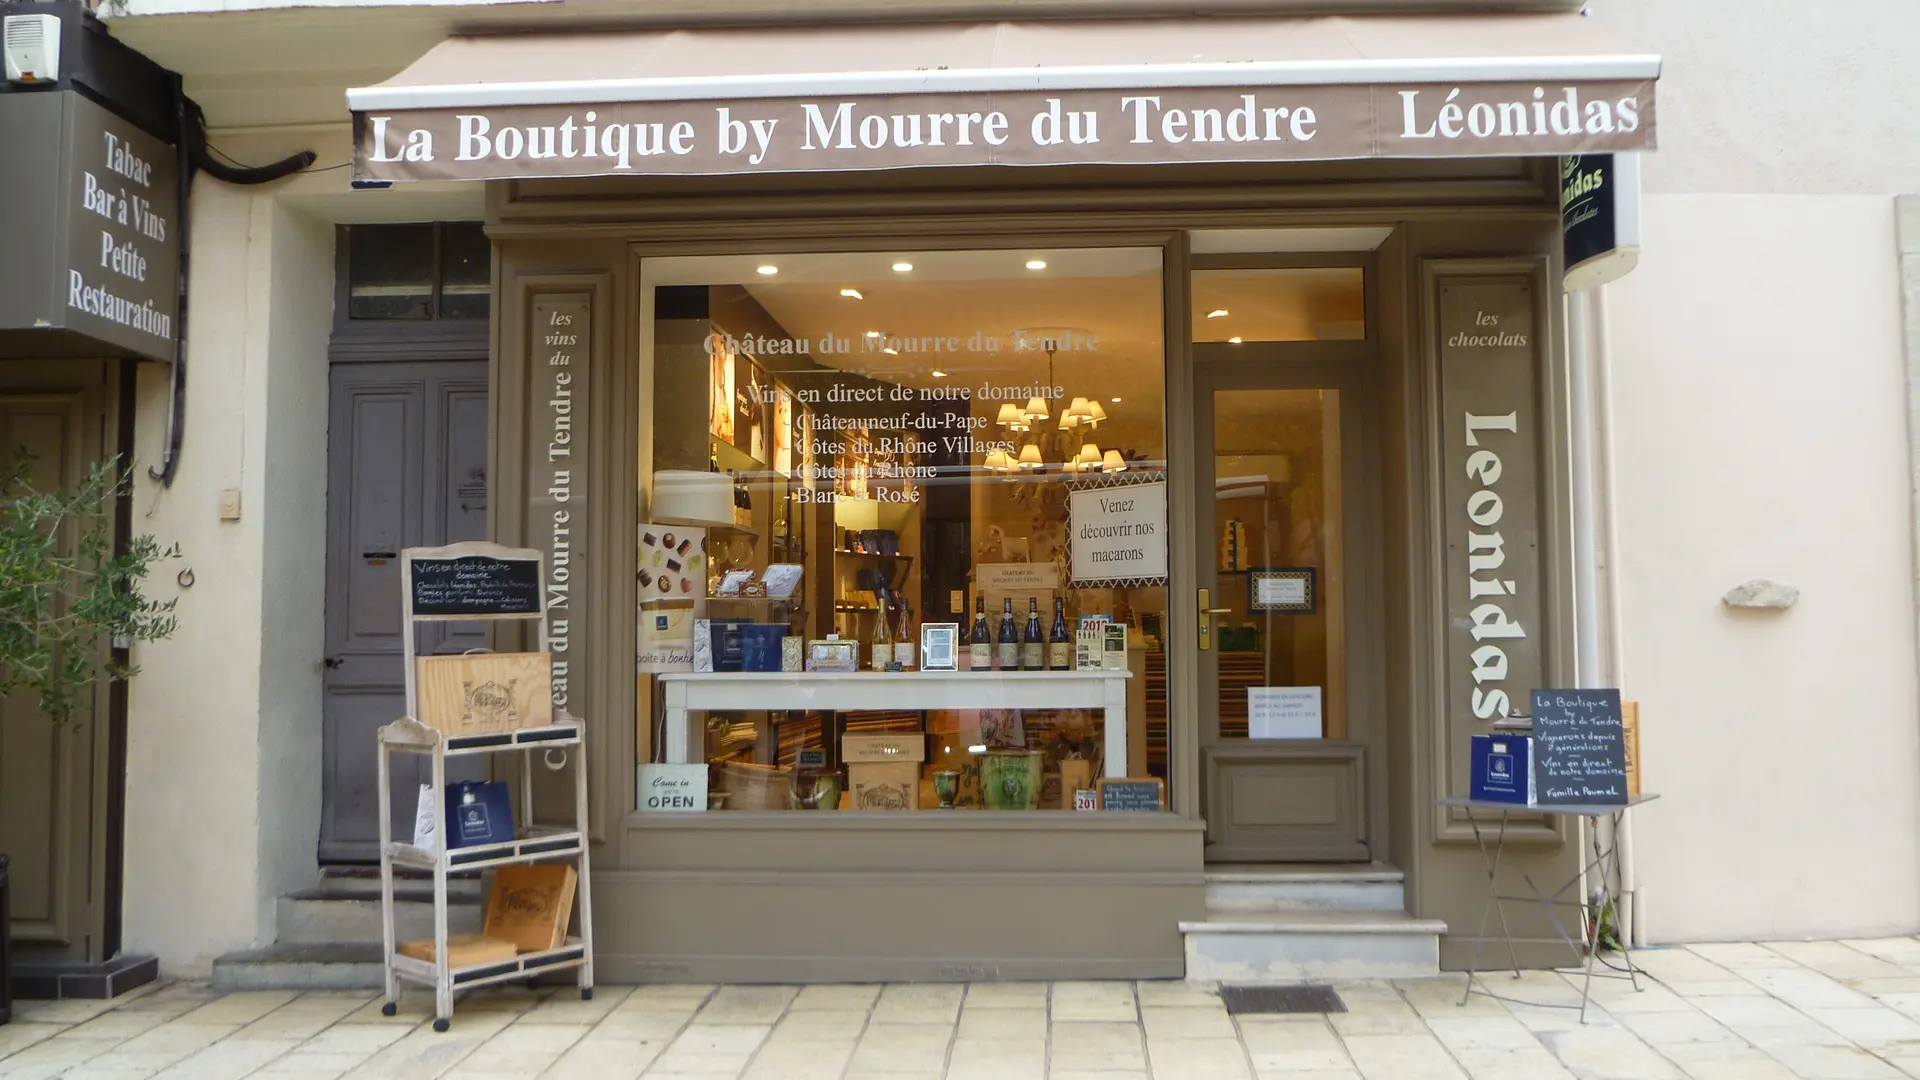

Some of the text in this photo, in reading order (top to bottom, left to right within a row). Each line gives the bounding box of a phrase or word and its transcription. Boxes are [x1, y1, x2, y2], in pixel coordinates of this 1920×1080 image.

[368, 86, 1640, 170] La Boutique by Mourre du Tendre Léonidas
[104, 131, 152, 188] Tabac
[83, 171, 166, 242] Bar à Vins
[100, 230, 147, 283] Petite
[68, 268, 171, 340] Restauration
[550, 311, 573, 326] les
[1475, 311, 1499, 326] les
[544, 331, 577, 346] vins
[703, 329, 1100, 355] Château du Mourre du Tendre
[1448, 331, 1528, 347] chocolats
[550, 351, 570, 366] du
[745, 384, 791, 404] Vins
[797, 388, 821, 403] en
[826, 383, 884, 402] direct
[890, 383, 914, 401] de
[920, 385, 971, 401] notre
[977, 380, 1065, 400] domaine
[549, 372, 572, 462] Tendre
[796, 412, 988, 433] Châteauneuf-du-Pape
[796, 436, 1015, 457] Côtes du Rhône Villages
[796, 463, 846, 479] Côtes
[851, 463, 874, 479] du
[879, 461, 937, 479] Rhône
[548, 470, 570, 503] du
[796, 485, 920, 503] Blanc & Rosé
[1100, 498, 1135, 514] Venez
[1080, 520, 1154, 540] découvrir nos
[547, 510, 570, 610] Mourre
[1092, 548, 1144, 562] macarons
[415, 562, 440, 573] Vins
[440, 563, 451, 572] en
[453, 560, 477, 571] direct
[1465, 410, 1526, 720] Leonidas
[548, 619, 569, 652] du
[1537, 695, 1609, 713] La Boutique
[1564, 708, 1576, 718] by
[1539, 715, 1622, 727] Mourre du Tendre
[1537, 731, 1616, 744] Vignerons depuis
[1556, 743, 1609, 755] générations
[1541, 756, 1560, 769] Vins
[1582, 758, 1613, 768] direct
[1548, 767, 1626, 776] de notre domaine
[652, 776, 689, 787] Come in
[648, 795, 694, 808] OPEN
[1547, 787, 1581, 798] Famille
